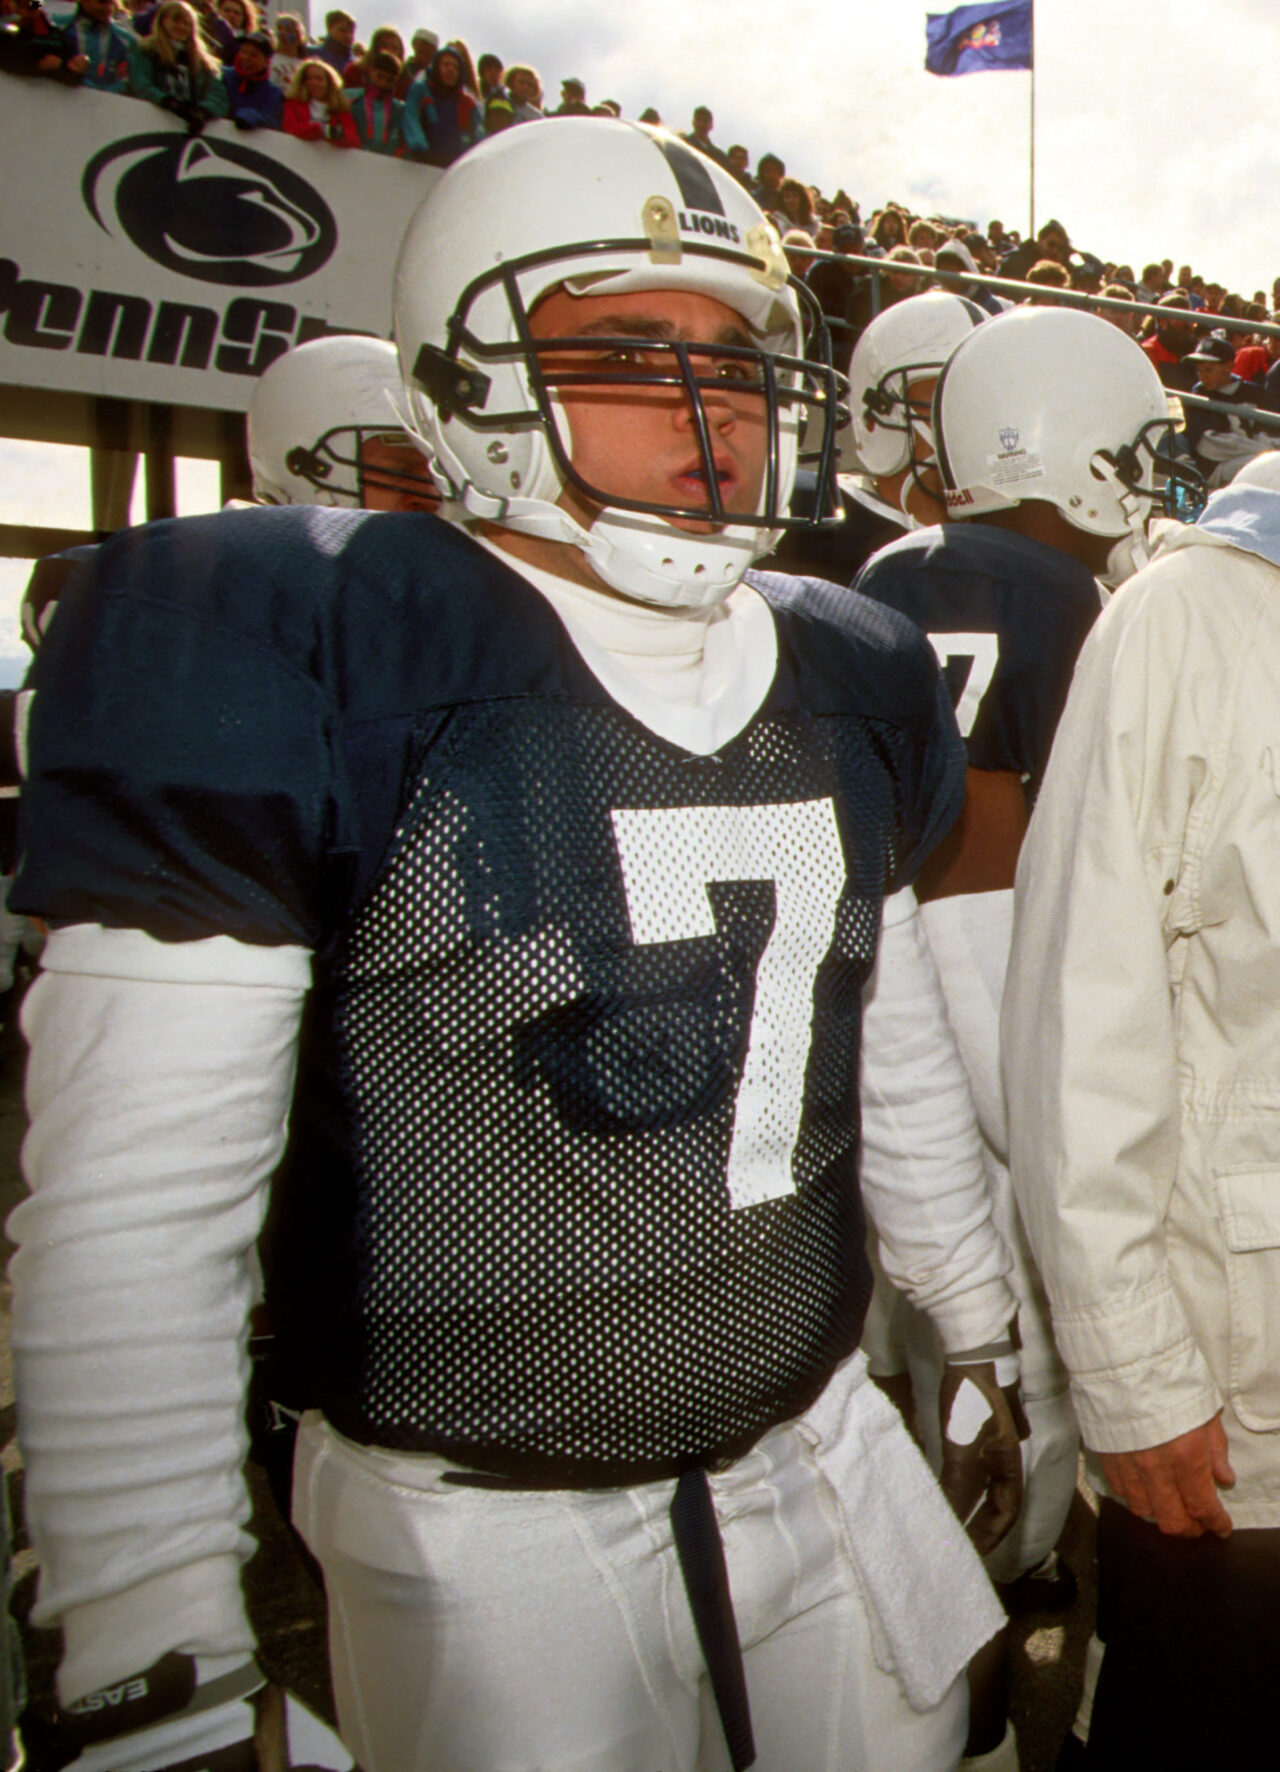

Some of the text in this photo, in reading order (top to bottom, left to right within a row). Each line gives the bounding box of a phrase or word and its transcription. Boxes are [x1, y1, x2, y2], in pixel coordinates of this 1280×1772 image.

[678, 211, 740, 244] LIONS
[926, 632, 999, 738] 7
[610, 796, 847, 1211] 7
